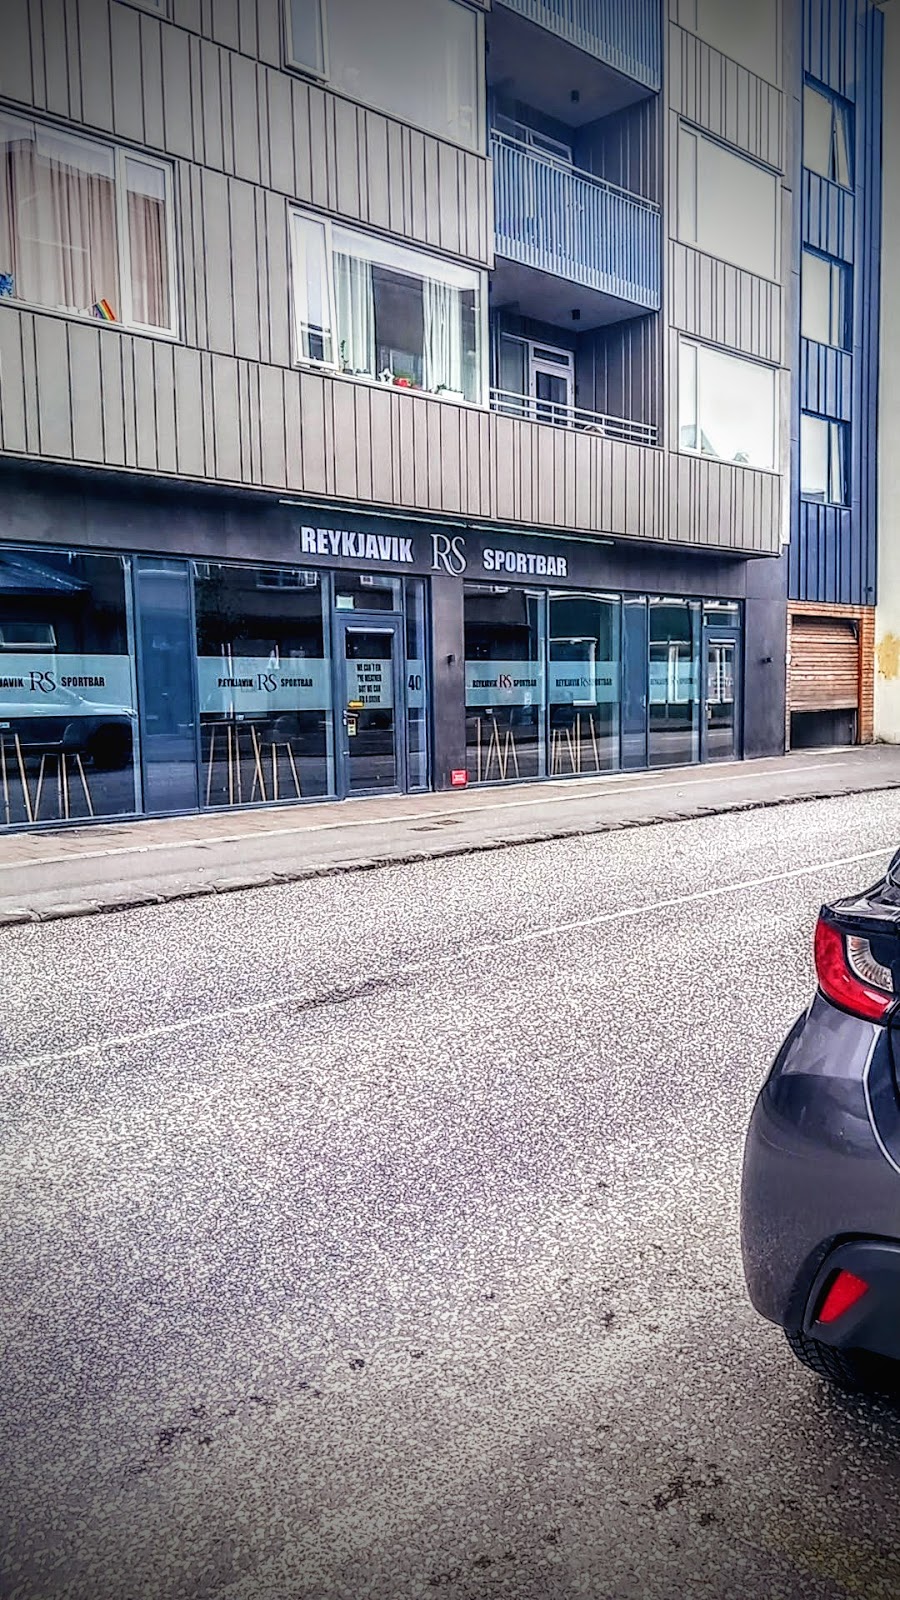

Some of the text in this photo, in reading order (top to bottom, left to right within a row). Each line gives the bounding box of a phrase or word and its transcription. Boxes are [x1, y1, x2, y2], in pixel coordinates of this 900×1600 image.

[300, 526, 567, 577] REYKJAVIK RS SPORTBAR
[29, 671, 56, 693] RS
[61, 676, 106, 687] SPORTBAR
[256, 673, 278, 692] RS
[280, 678, 313, 687] SPORTBAR
[408, 675, 422, 690] 40
[499, 674, 512, 688] RS
